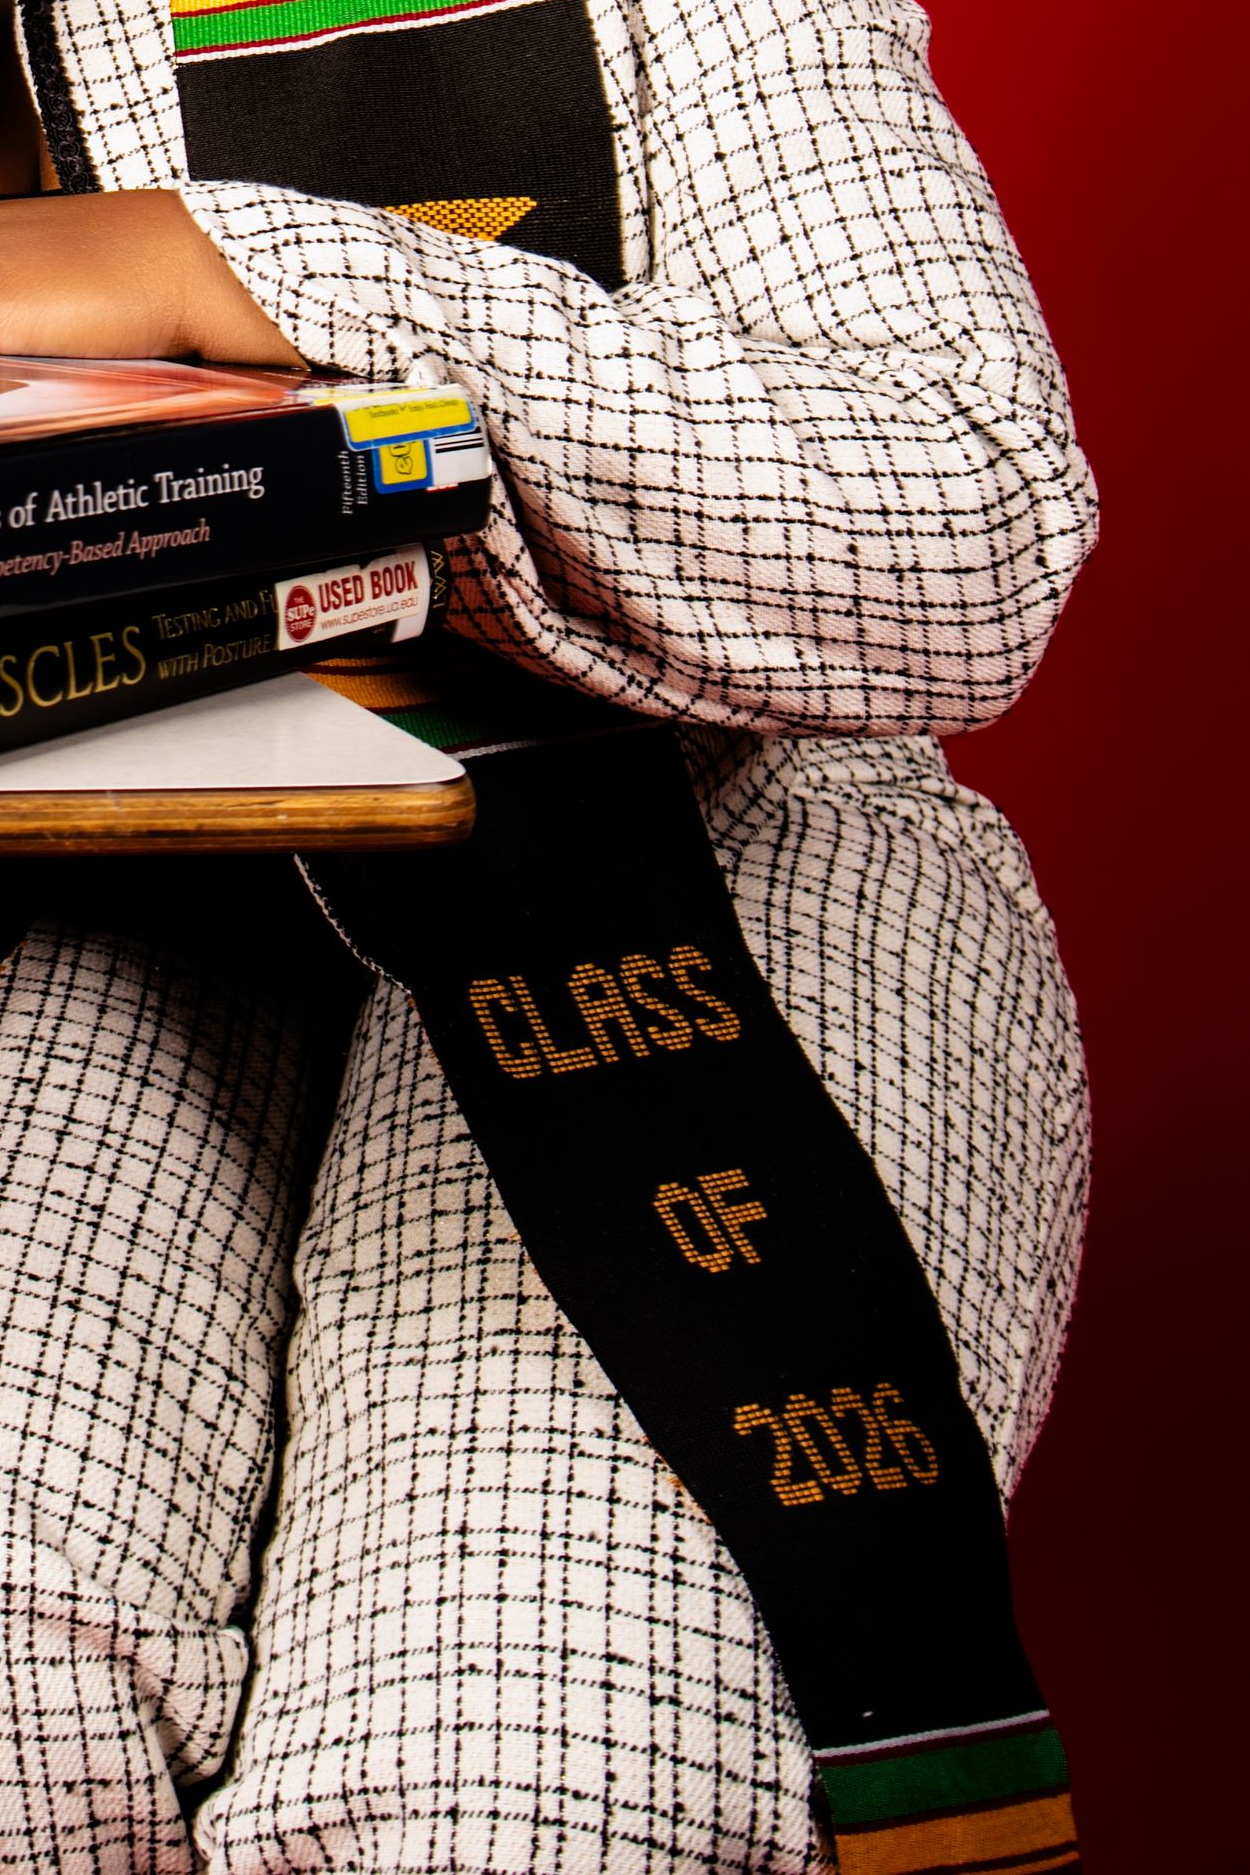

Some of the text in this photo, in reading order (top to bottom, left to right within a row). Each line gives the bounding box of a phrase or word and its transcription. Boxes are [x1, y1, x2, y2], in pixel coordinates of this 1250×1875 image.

[8, 491, 39, 529] of
[45, 479, 149, 523] Athletic
[153, 462, 265, 503] Training
[338, 450, 354, 515] Fifteenth
[356, 454, 369, 505] Edition
[125, 517, 211, 561] Approach
[293, 595, 306, 605] THE
[317, 573, 365, 614] USED
[370, 559, 419, 602] BOOK
[318, 595, 420, 631] www.supestore.ua.edu
[288, 619, 314, 633] STORE
[468, 944, 742, 1079] CLASS
[652, 1167, 768, 1274] OF
[732, 1381, 940, 1507] 2026
